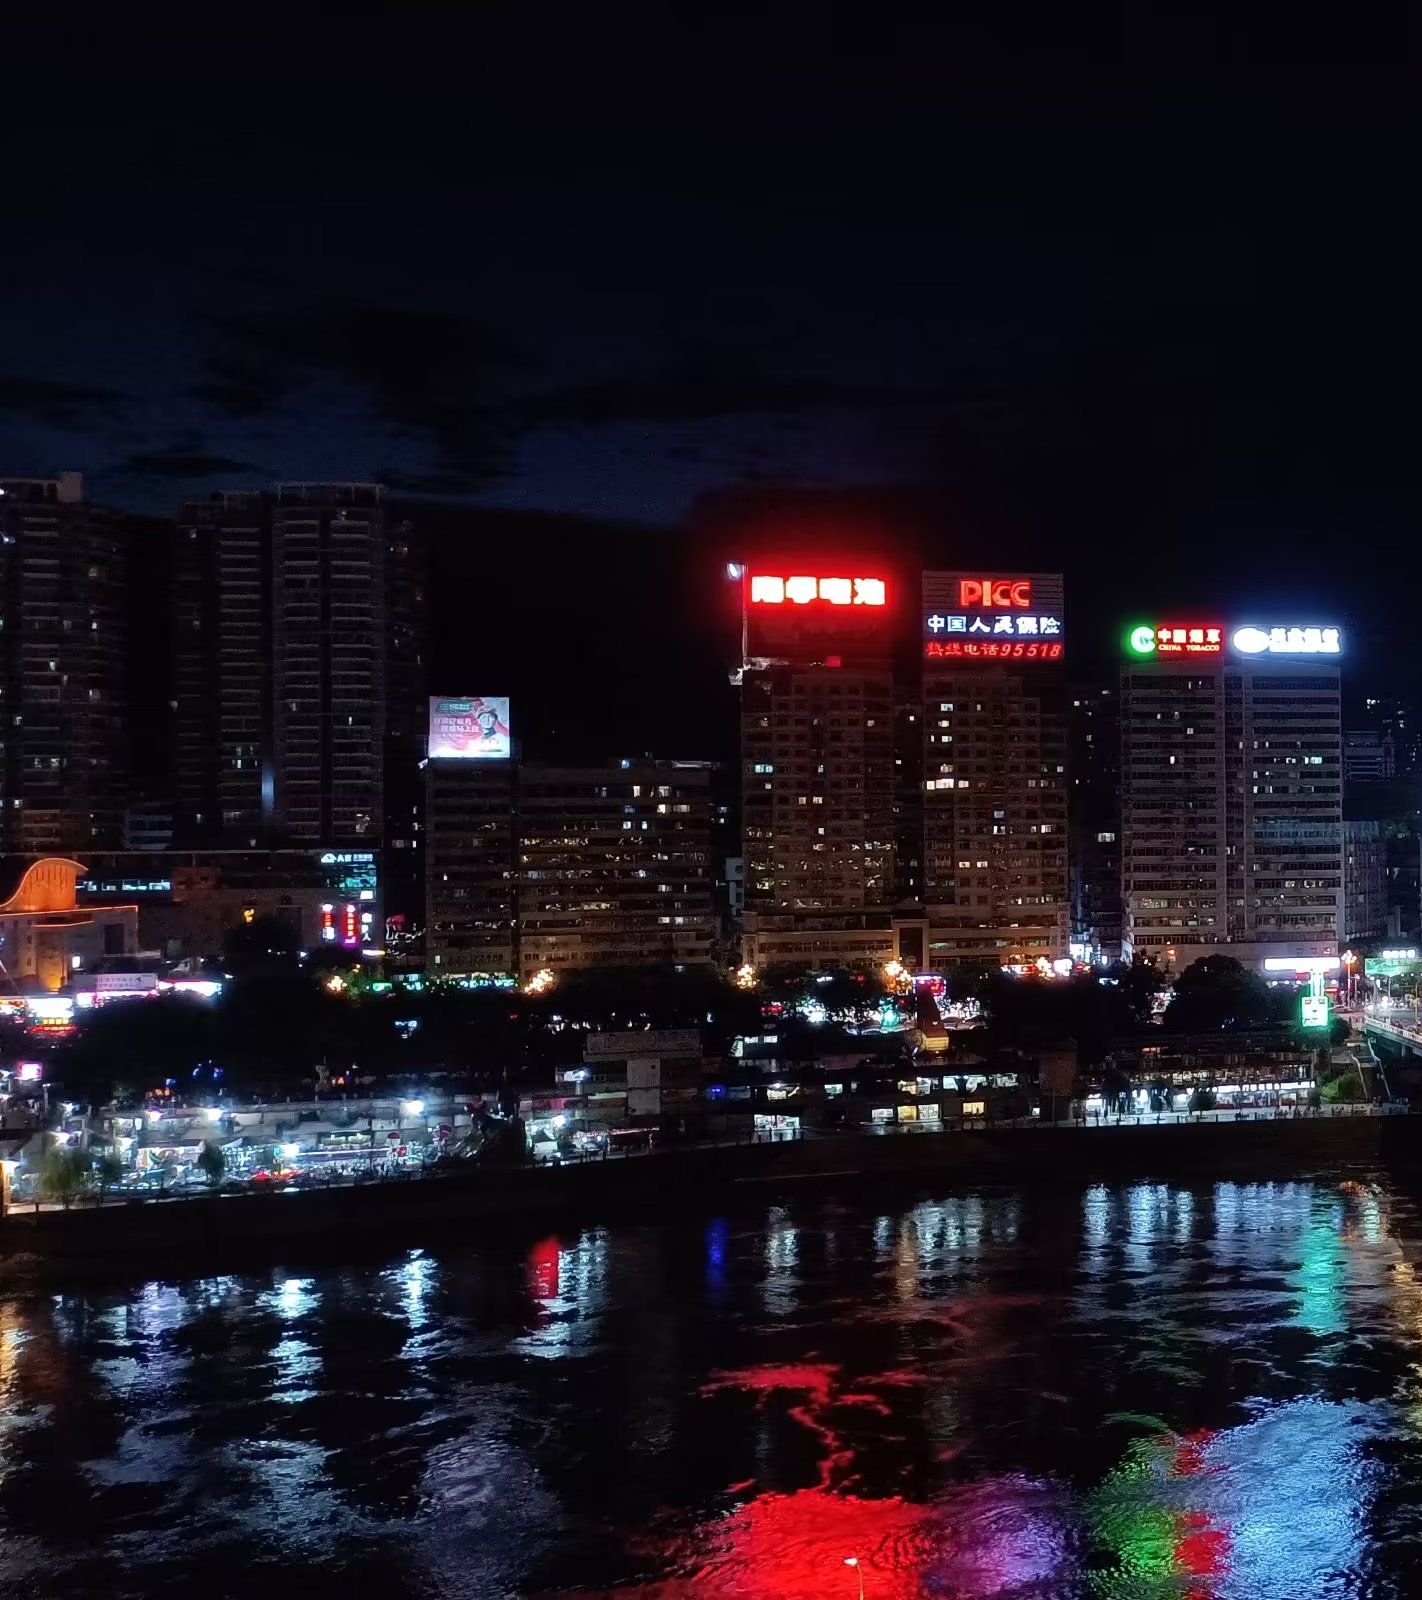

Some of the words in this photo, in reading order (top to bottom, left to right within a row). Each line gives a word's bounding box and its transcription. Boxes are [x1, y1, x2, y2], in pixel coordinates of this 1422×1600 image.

[959, 579, 1030, 607] PICC
[927, 614, 1061, 635] 中国人民保险
